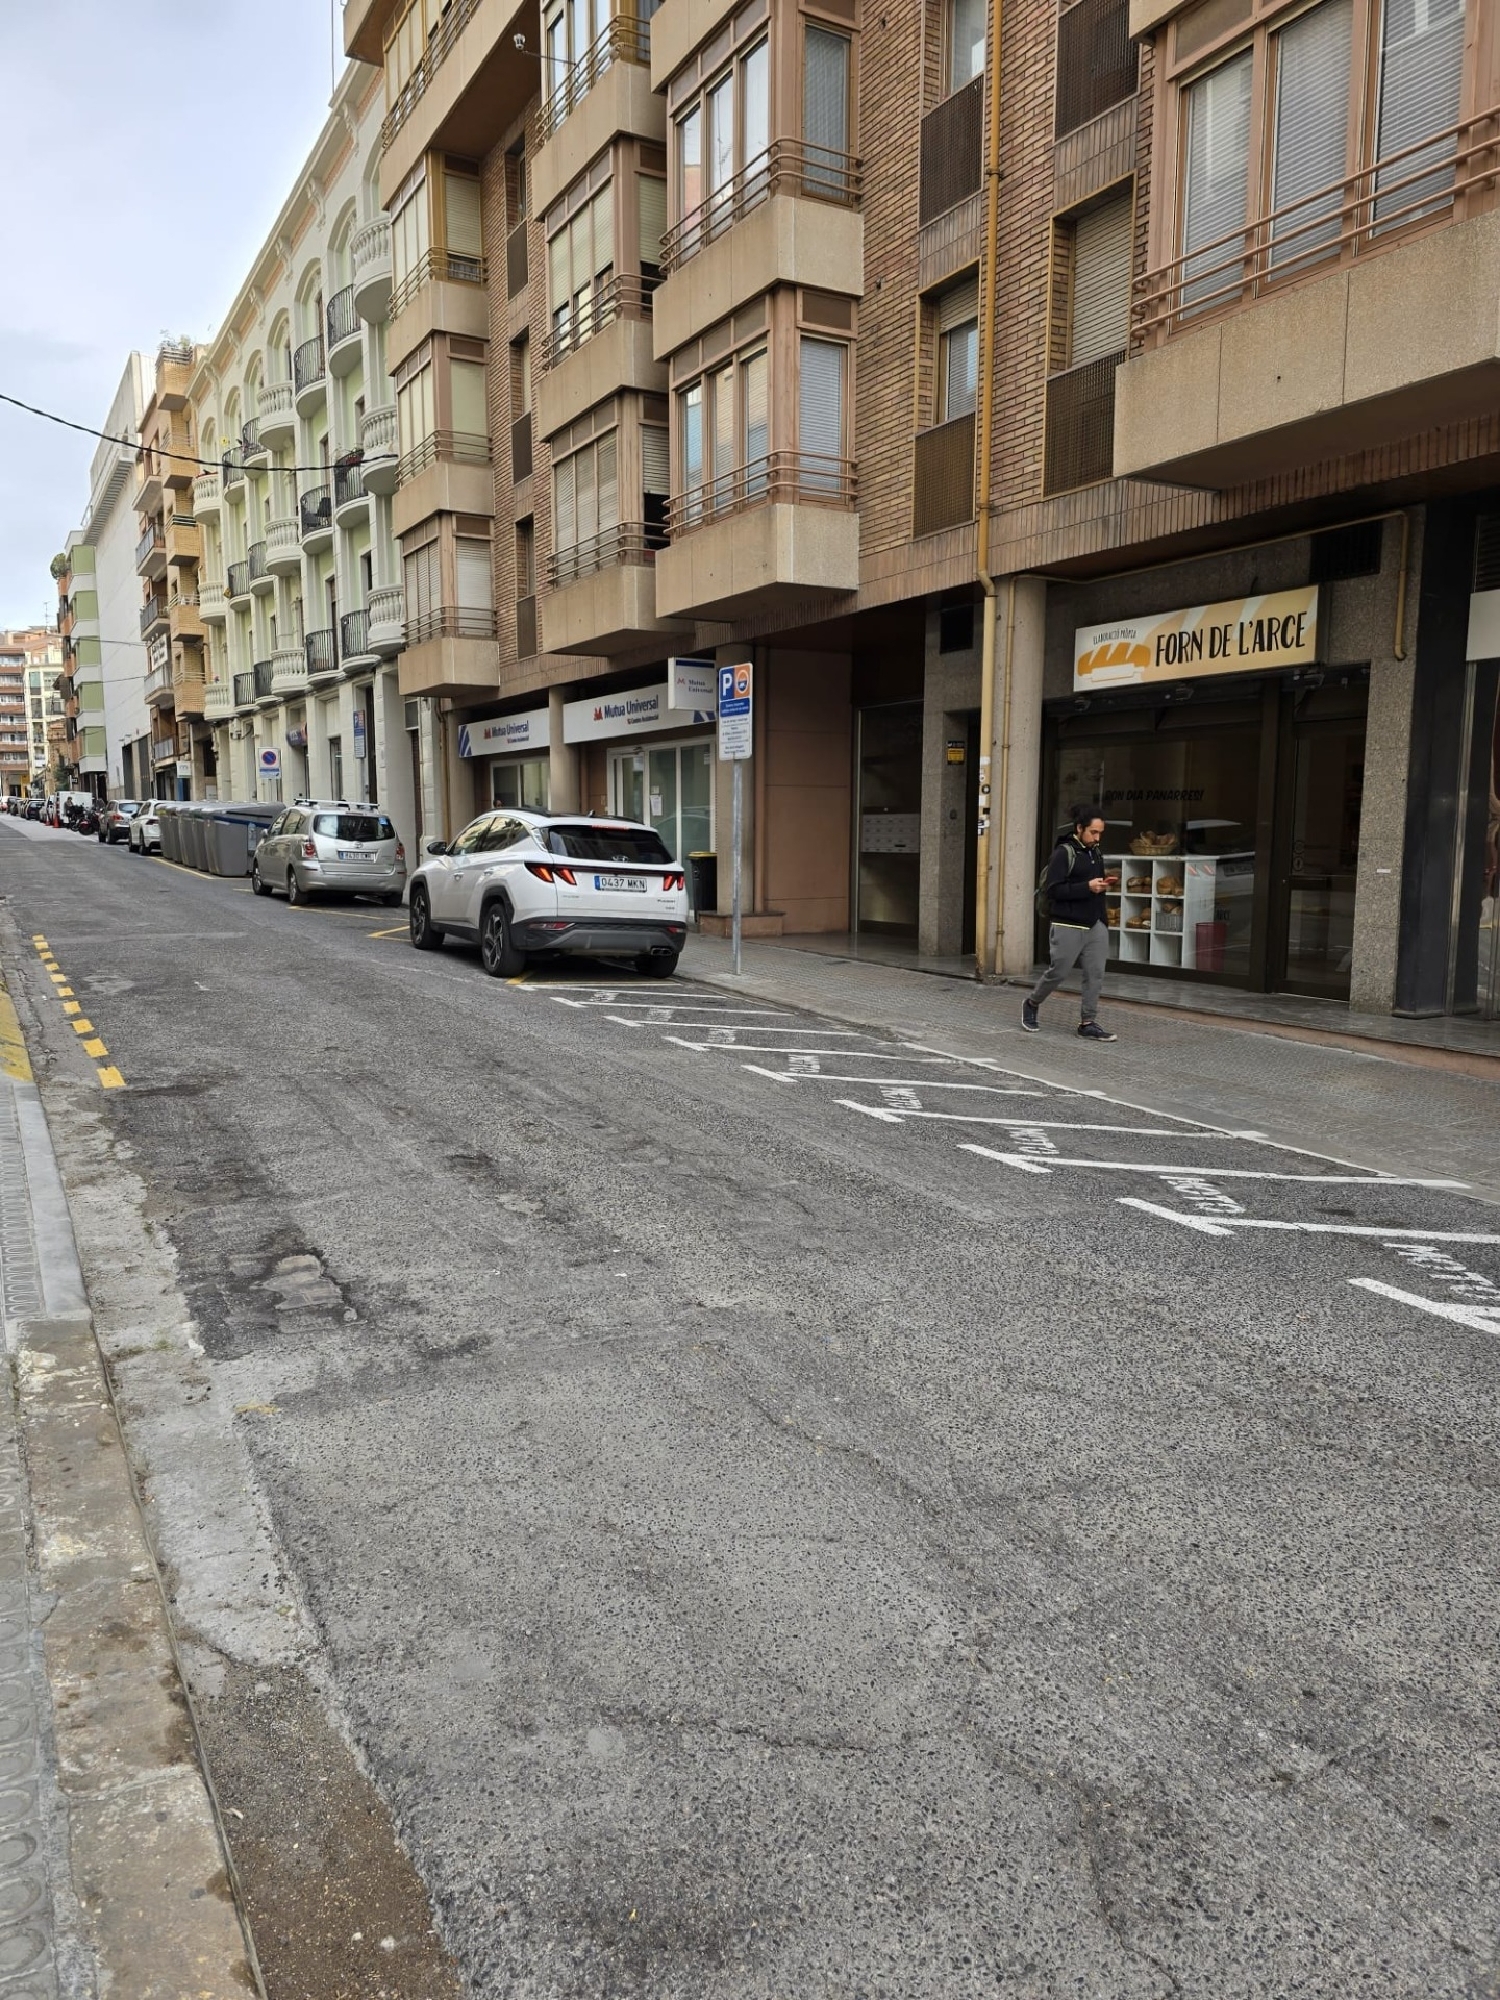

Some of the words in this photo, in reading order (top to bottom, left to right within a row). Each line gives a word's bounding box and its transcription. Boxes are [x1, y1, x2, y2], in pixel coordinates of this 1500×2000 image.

[1155, 629, 1203, 667] FORN
[1208, 623, 1233, 658] DE
[1238, 611, 1307, 656] L'ARCE
[722, 673, 732, 696] P
[604, 704, 625, 718] Mutua
[626, 694, 659, 715] Universal
[491, 724, 506, 737] Mutua
[506, 719, 529, 735] Universal
[601, 877, 625, 888] 0437
[627, 879, 645, 890] MKN
